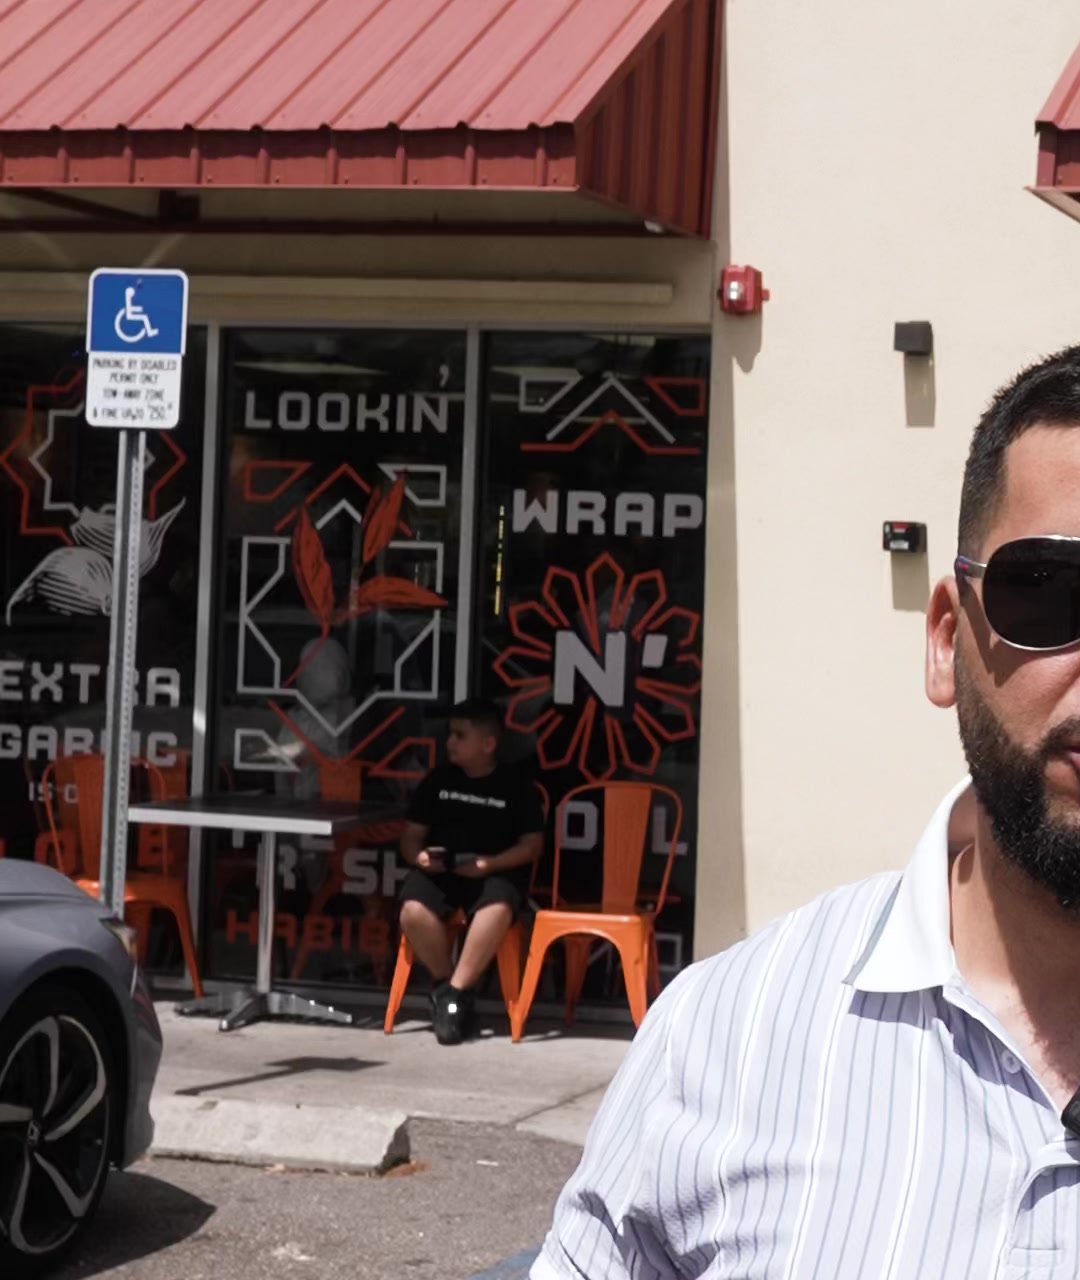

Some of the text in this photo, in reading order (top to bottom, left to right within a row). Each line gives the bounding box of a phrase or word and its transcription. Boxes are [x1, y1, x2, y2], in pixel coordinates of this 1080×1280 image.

[244, 365, 449, 433] LOOKIN'
[512, 488, 704, 538] WRAP
[0, 660, 182, 708] EXTA
[226, 908, 390, 955] HABIB
